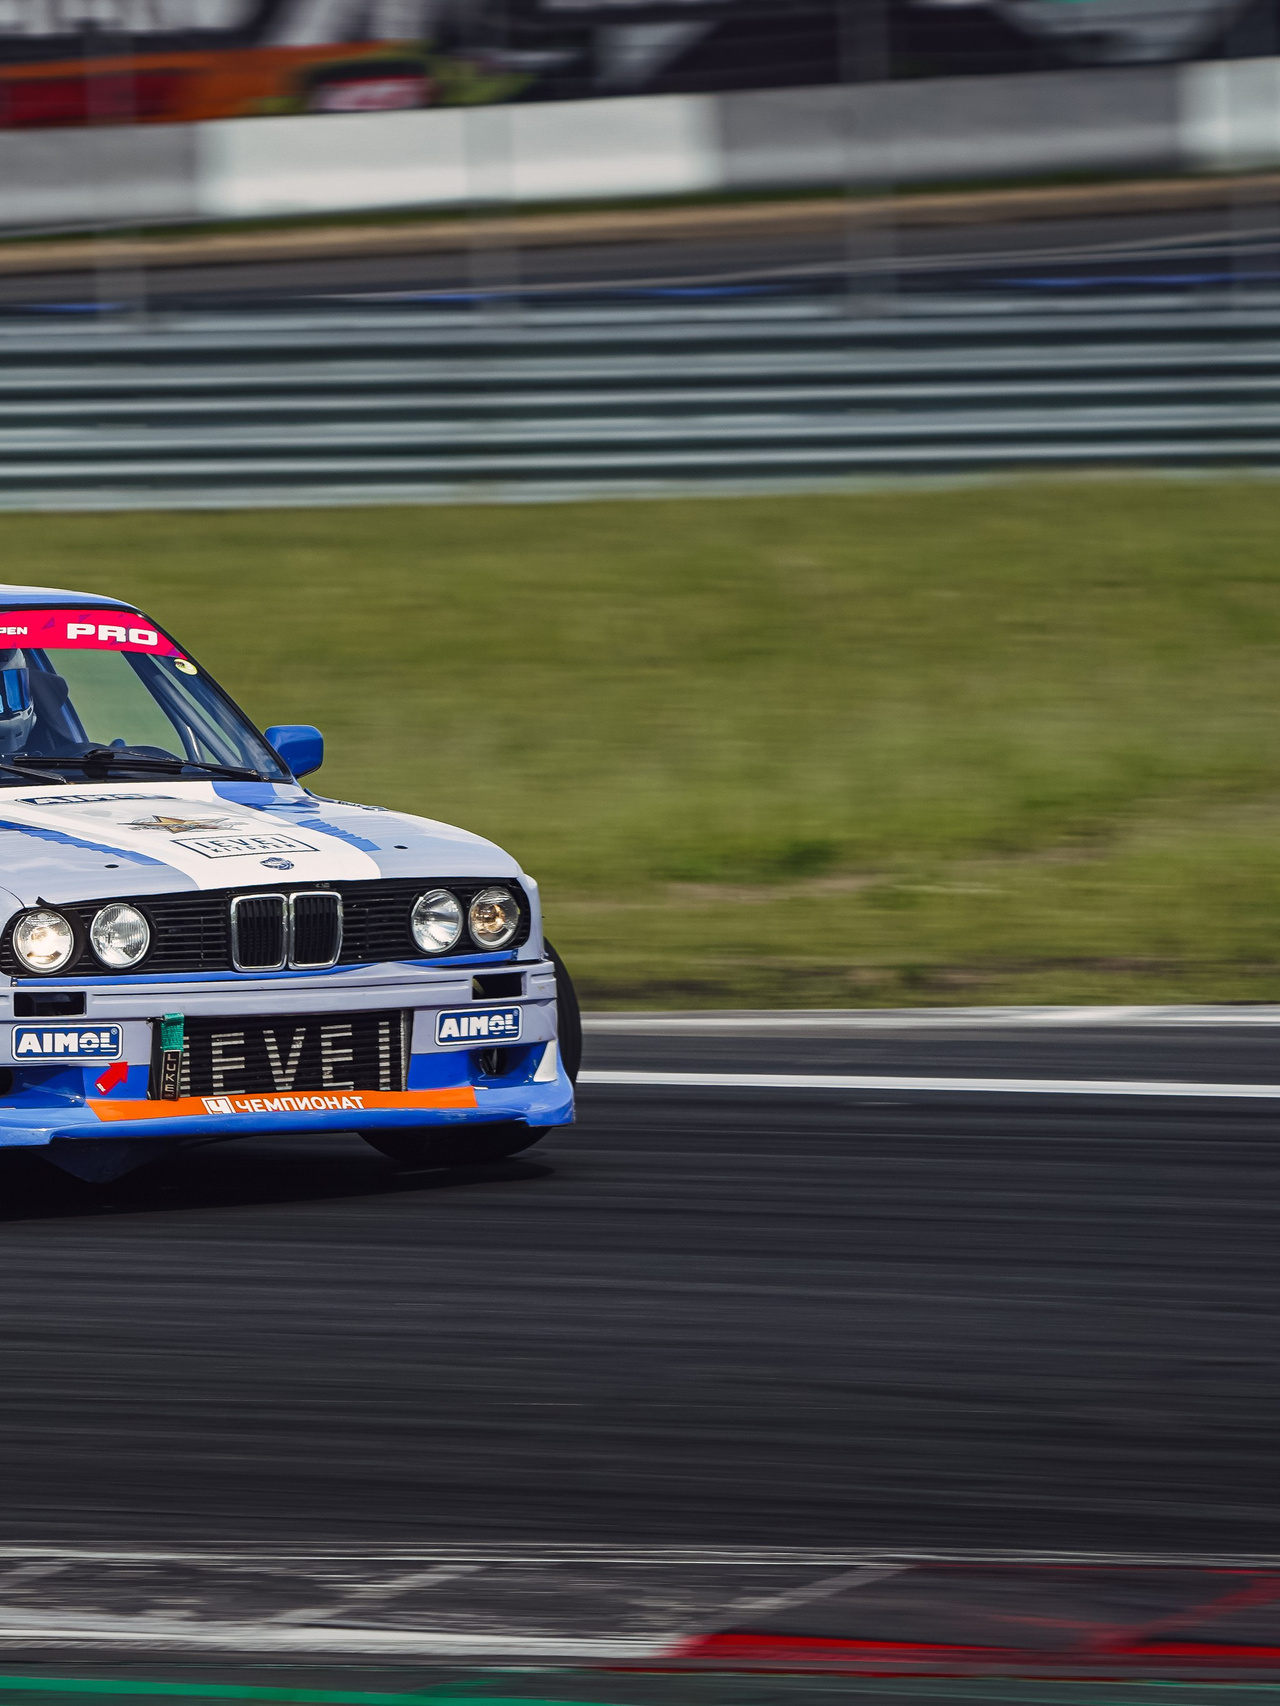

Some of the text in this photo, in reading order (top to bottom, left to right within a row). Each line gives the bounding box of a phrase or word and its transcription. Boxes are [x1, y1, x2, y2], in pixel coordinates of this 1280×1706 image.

[67, 623, 158, 646] PRO
[439, 1013, 519, 1039] AIMOL
[17, 1032, 117, 1053] AIMOL
[164, 1053, 177, 1093] LUKE
[235, 1096, 364, 1113] ЧЕМПИОНАТ
